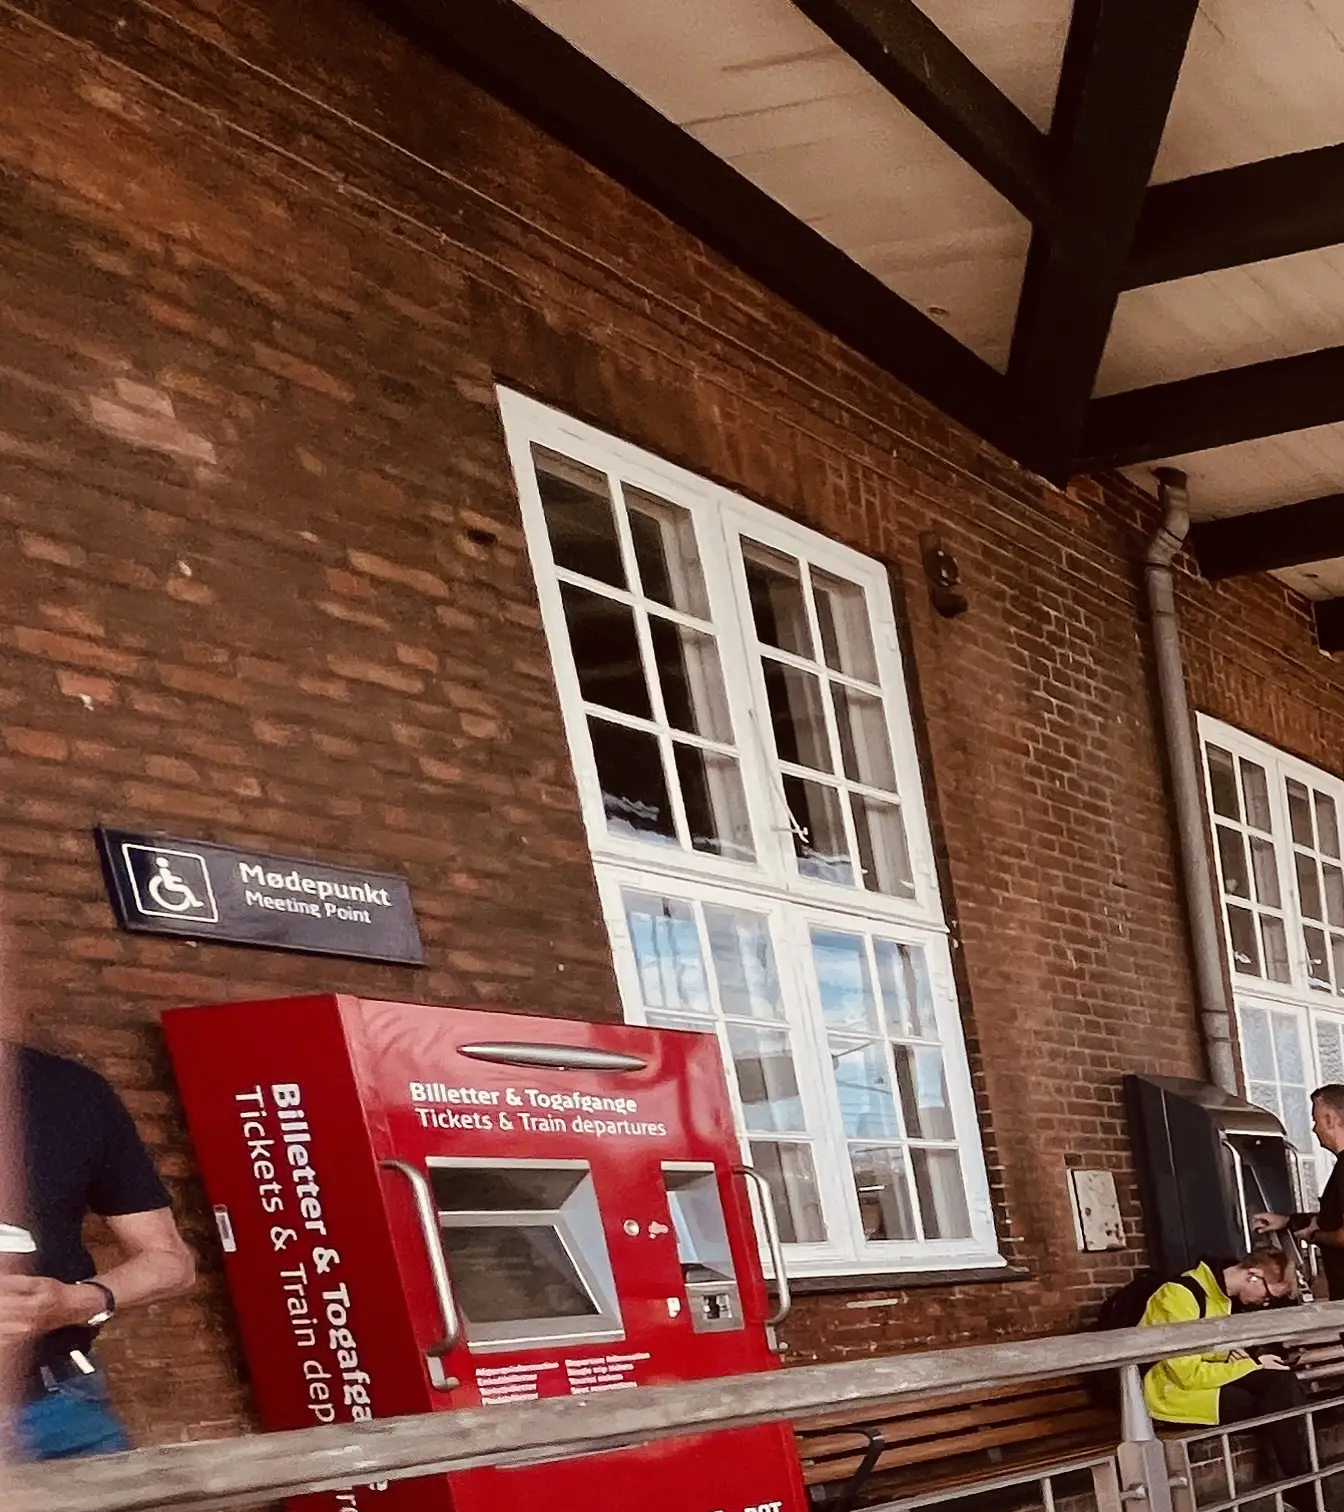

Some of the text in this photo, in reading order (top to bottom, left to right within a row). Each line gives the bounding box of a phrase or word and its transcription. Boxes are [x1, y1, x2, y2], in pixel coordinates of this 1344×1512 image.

[239, 862, 393, 907] Mødepunkt
[245, 890, 372, 924] Meeting Point
[409, 1082, 638, 1115] Billetter & Togafgange
[415, 1107, 667, 1137] Tickets & Train departures
[235, 1084, 284, 1213] Tickets
[271, 1083, 327, 1236] Billetter
[312, 1246, 340, 1274] &
[270, 1226, 298, 1251] &
[280, 1262, 318, 1347] Train
